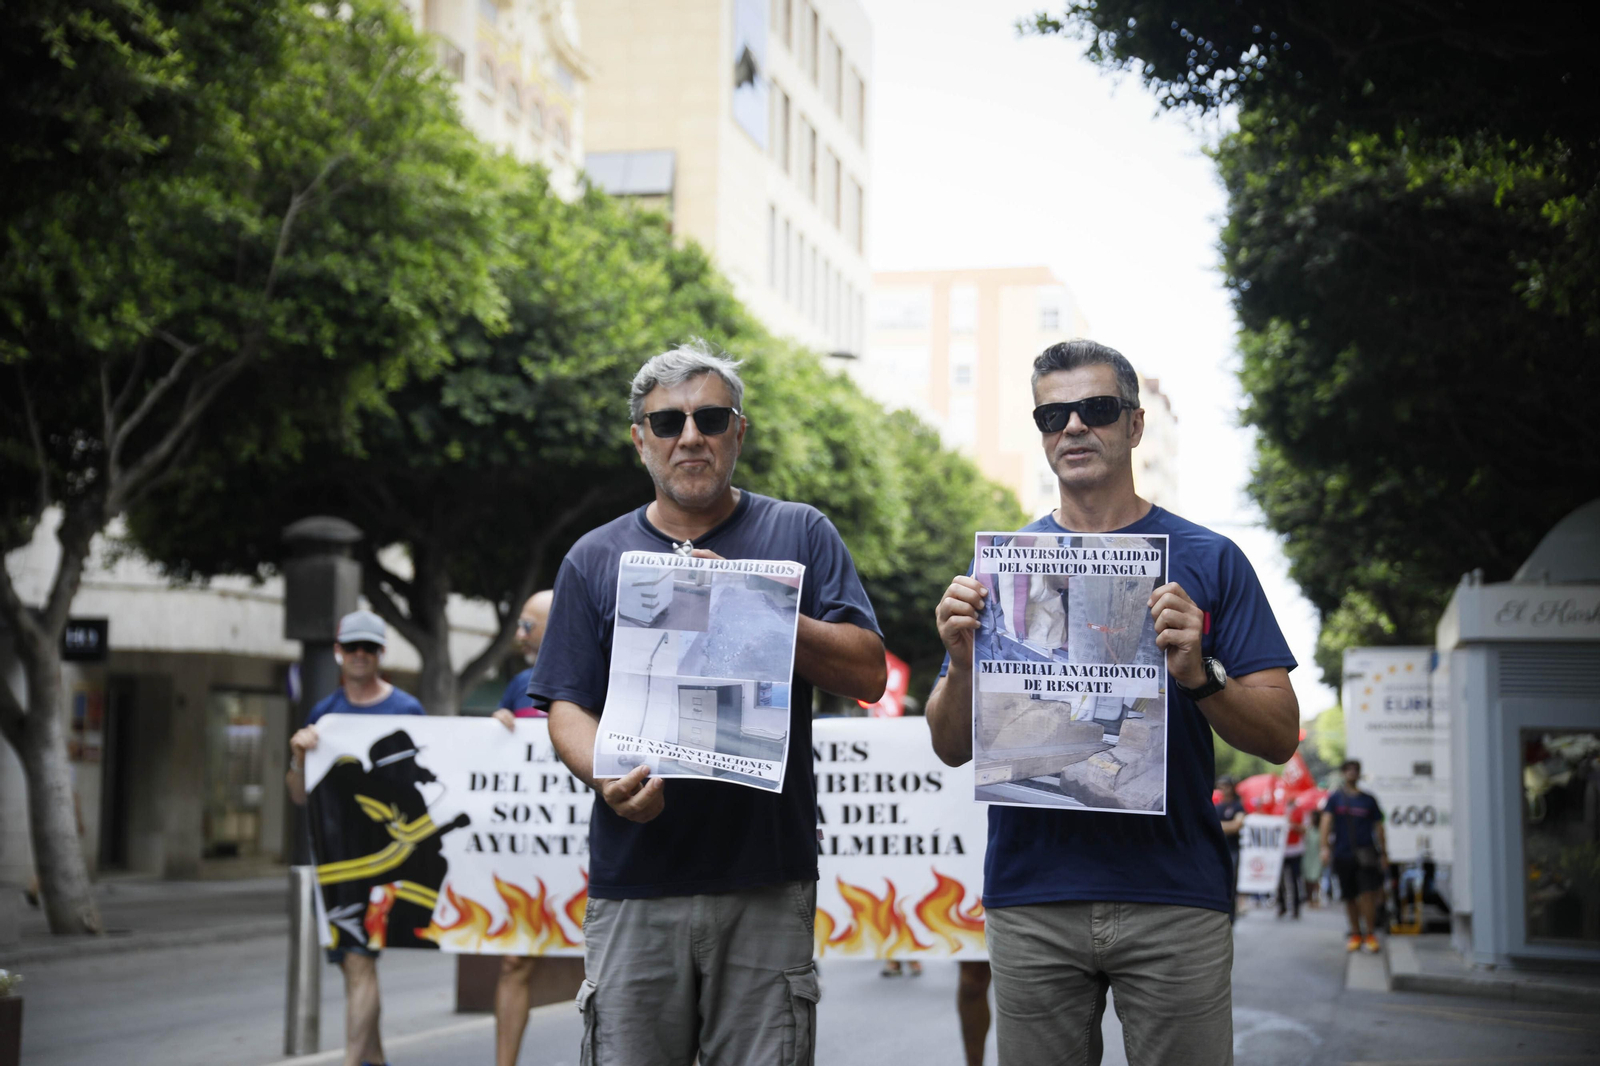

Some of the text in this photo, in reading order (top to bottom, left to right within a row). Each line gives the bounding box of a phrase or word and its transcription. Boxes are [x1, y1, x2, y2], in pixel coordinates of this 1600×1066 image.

[982, 546, 1160, 562] SIN INVERSIÓN LA CALIDAD
[629, 553, 796, 576] DIGNIDAD BOMBEROS
[999, 562, 1147, 576] DEL SERVICIO MENGUA
[981, 661, 1157, 680] MATERIAL ANACRÓNICO
[1024, 679, 1113, 694] DE RESCATE
[608, 732, 773, 771] POR UNAS INSTALACIONES
[616, 742, 643, 753] QUE
[649, 746, 664, 757] NO
[668, 750, 692, 761] DEN
[468, 772, 528, 793] DEL
[491, 802, 556, 824] SON
[841, 803, 908, 825] DEL
